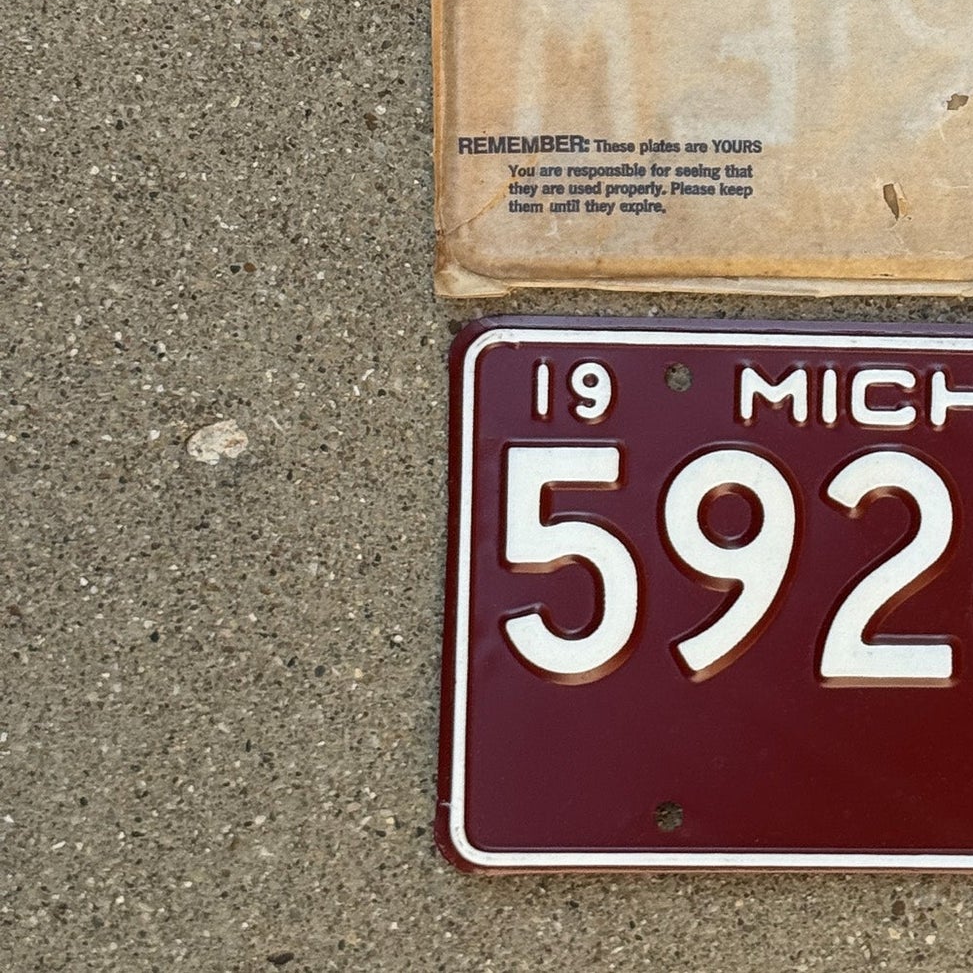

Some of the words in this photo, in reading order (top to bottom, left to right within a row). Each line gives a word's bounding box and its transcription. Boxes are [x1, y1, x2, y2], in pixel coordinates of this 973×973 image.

[457, 134, 591, 155] REMEMBER:
[593, 138, 636, 154] These
[639, 137, 682, 156] plates
[684, 141, 709, 154] are
[711, 138, 764, 154] YOURS
[508, 163, 536, 178] You
[539, 165, 563, 178] are
[566, 162, 647, 181] responsible
[649, 162, 672, 178] for
[674, 163, 722, 181] seeing
[724, 163, 754, 179] that
[508, 181, 539, 199] they
[541, 183, 566, 196] are
[568, 180, 602, 195] used
[604, 180, 668, 199] properly.
[670, 180, 717, 196] Please
[718, 181, 754, 200] keep
[508, 199, 544, 214] them
[548, 198, 581, 213] until
[584, 198, 617, 217] they
[618, 198, 667, 216] expire.
[535, 360, 613, 421] 19
